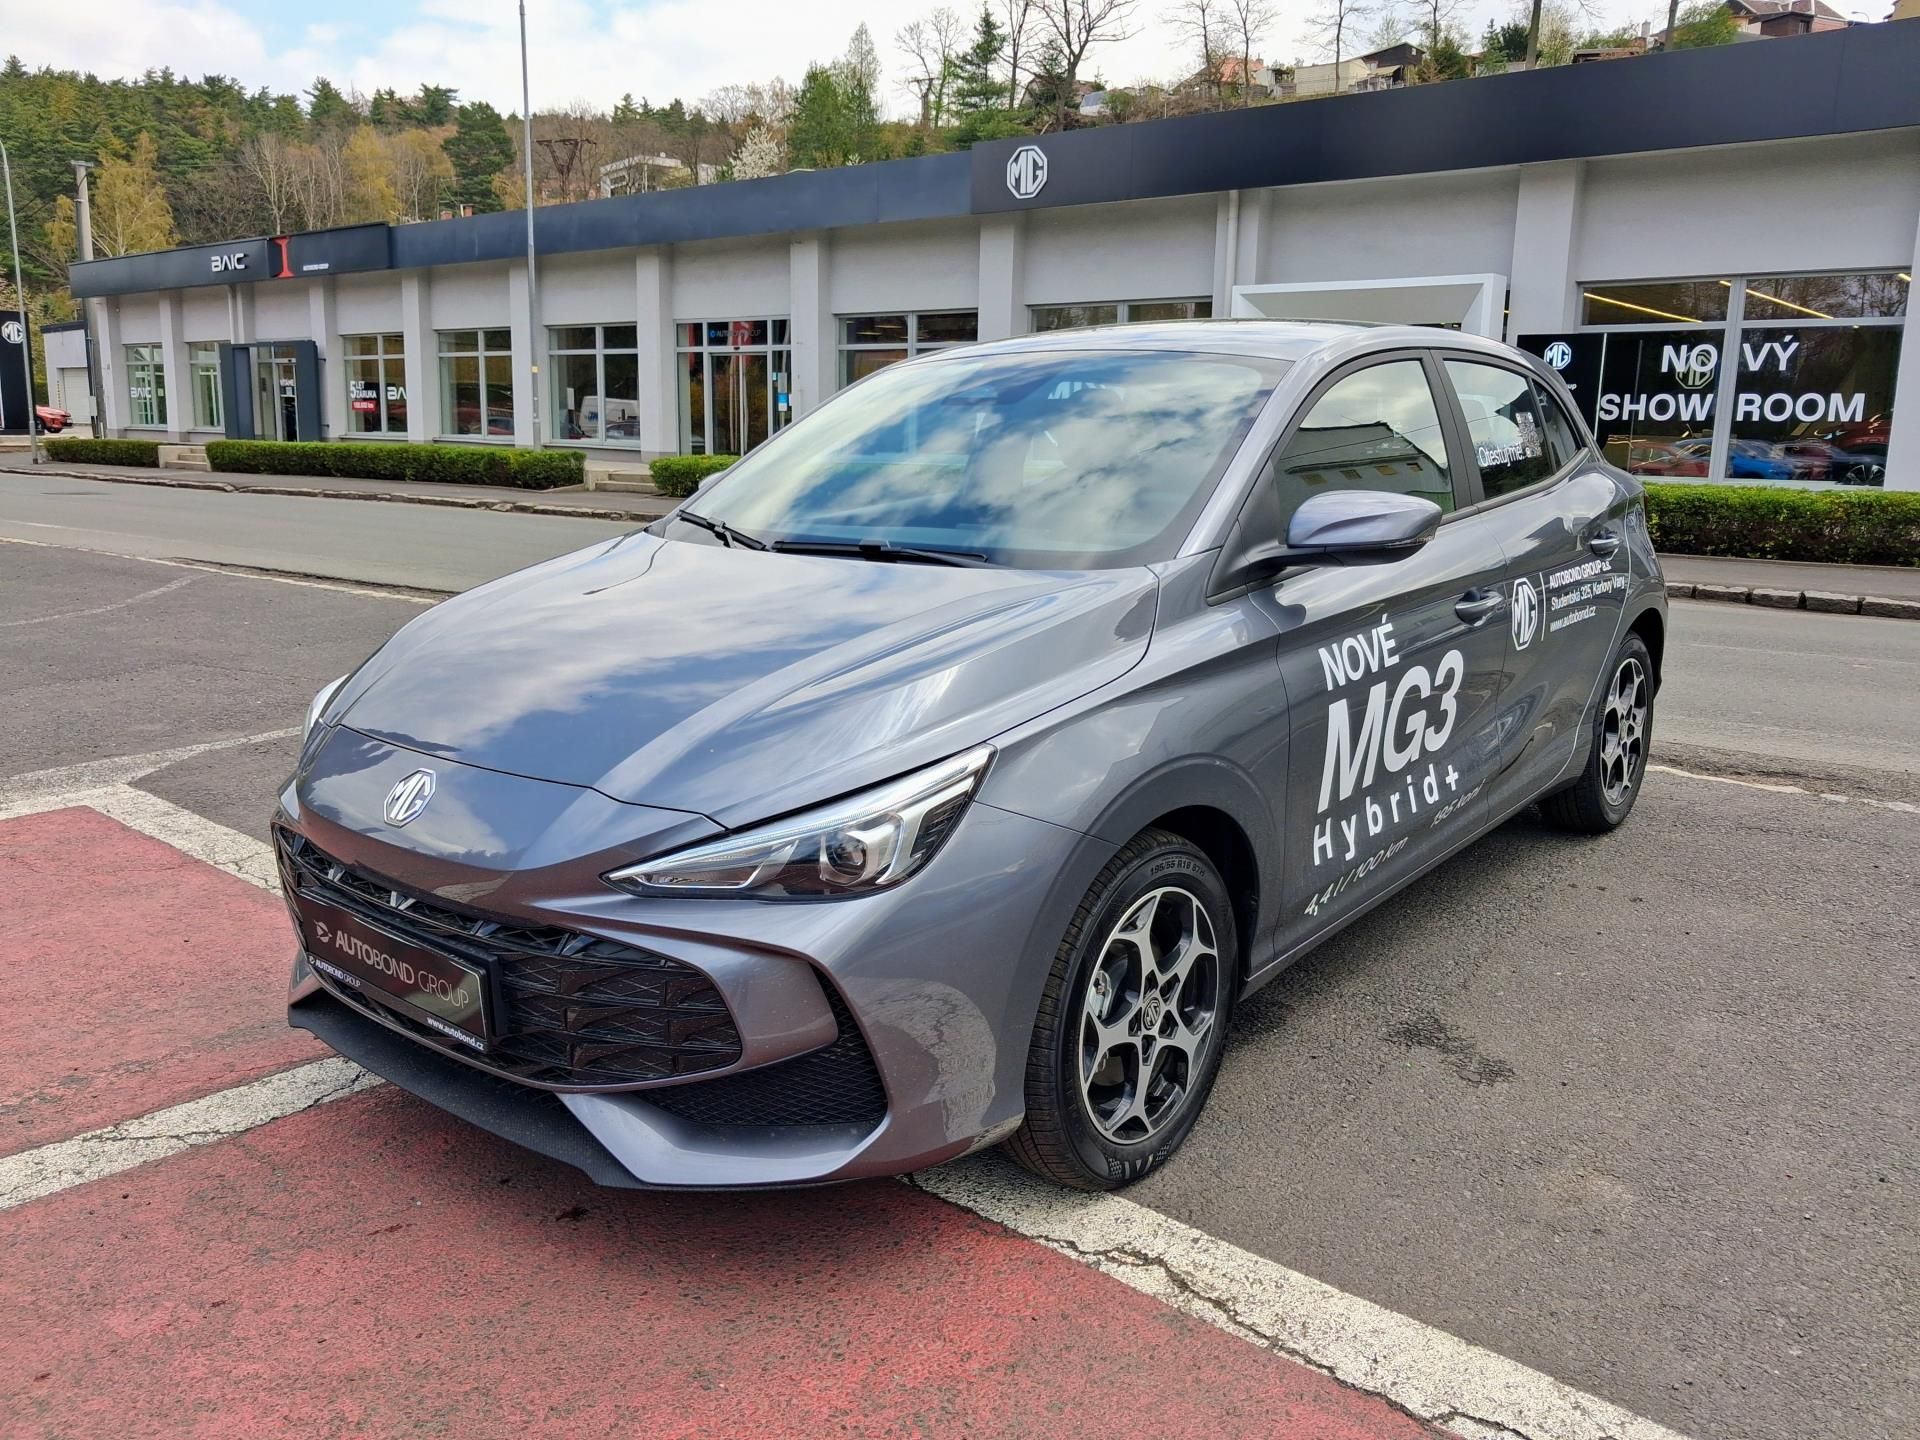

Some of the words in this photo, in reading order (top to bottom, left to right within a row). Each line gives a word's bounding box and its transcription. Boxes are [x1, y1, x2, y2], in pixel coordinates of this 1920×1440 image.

[1008, 146, 1047, 198] MG
[211, 253, 245, 272] BAIC
[1544, 342, 1571, 369] MG
[387, 386, 407, 400] BA
[1599, 393, 1715, 422] SHOW
[1736, 393, 1865, 422] ROOM
[1549, 565, 1581, 589] AUTOBOND
[1581, 559, 1601, 578] GROUP
[1512, 578, 1537, 650] MG
[1549, 605, 1597, 632] www.autobond.cz
[1318, 613, 1400, 691] NOVÉ
[1317, 649, 1464, 814] MG3
[384, 768, 436, 828] MG
[315, 959, 344, 980] AUTOBOND
[343, 973, 361, 987] GROUP
[336, 930, 415, 985] AUTOBOND
[418, 970, 469, 1009] GROUP
[426, 1016, 485, 1051] www.autobond.cz
